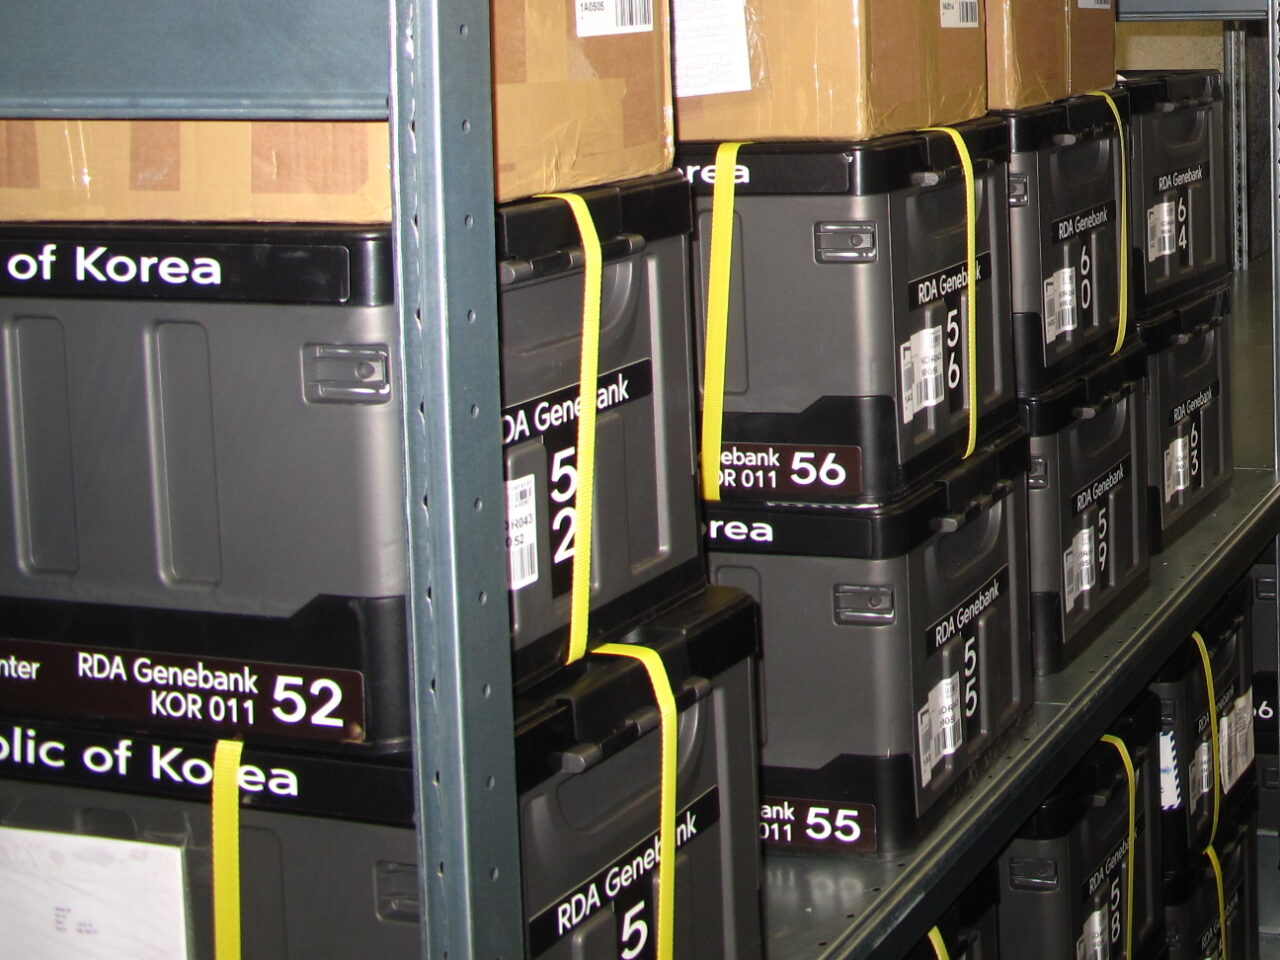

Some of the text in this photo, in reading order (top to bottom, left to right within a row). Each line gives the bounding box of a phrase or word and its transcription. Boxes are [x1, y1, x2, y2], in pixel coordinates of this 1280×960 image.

[680, 164, 750, 184] rea
[1159, 165, 1203, 192] RDA Genebank
[1058, 206, 1108, 241] RDA Genebank
[7, 243, 222, 285] of Korea
[918, 261, 981, 305] RDA Genebk
[503, 374, 630, 444] DA Geneank
[1174, 385, 1213, 423] RDA Genebank
[720, 447, 780, 467] ebank
[790, 452, 847, 486] 56
[741, 470, 776, 488] 011
[1077, 463, 1124, 513] RDA Genebank
[709, 520, 774, 542] rea
[935, 578, 1000, 648] RDA Genebank
[78, 652, 128, 682] RDA
[133, 657, 260, 694] Genebank
[151, 690, 255, 725] KOR 011
[272, 675, 345, 728] 52
[84, 741, 133, 776] of
[151, 744, 299, 797] Koea
[760, 801, 795, 821] ank
[805, 806, 861, 842] 55
[557, 811, 698, 936] RDA Genebnk
